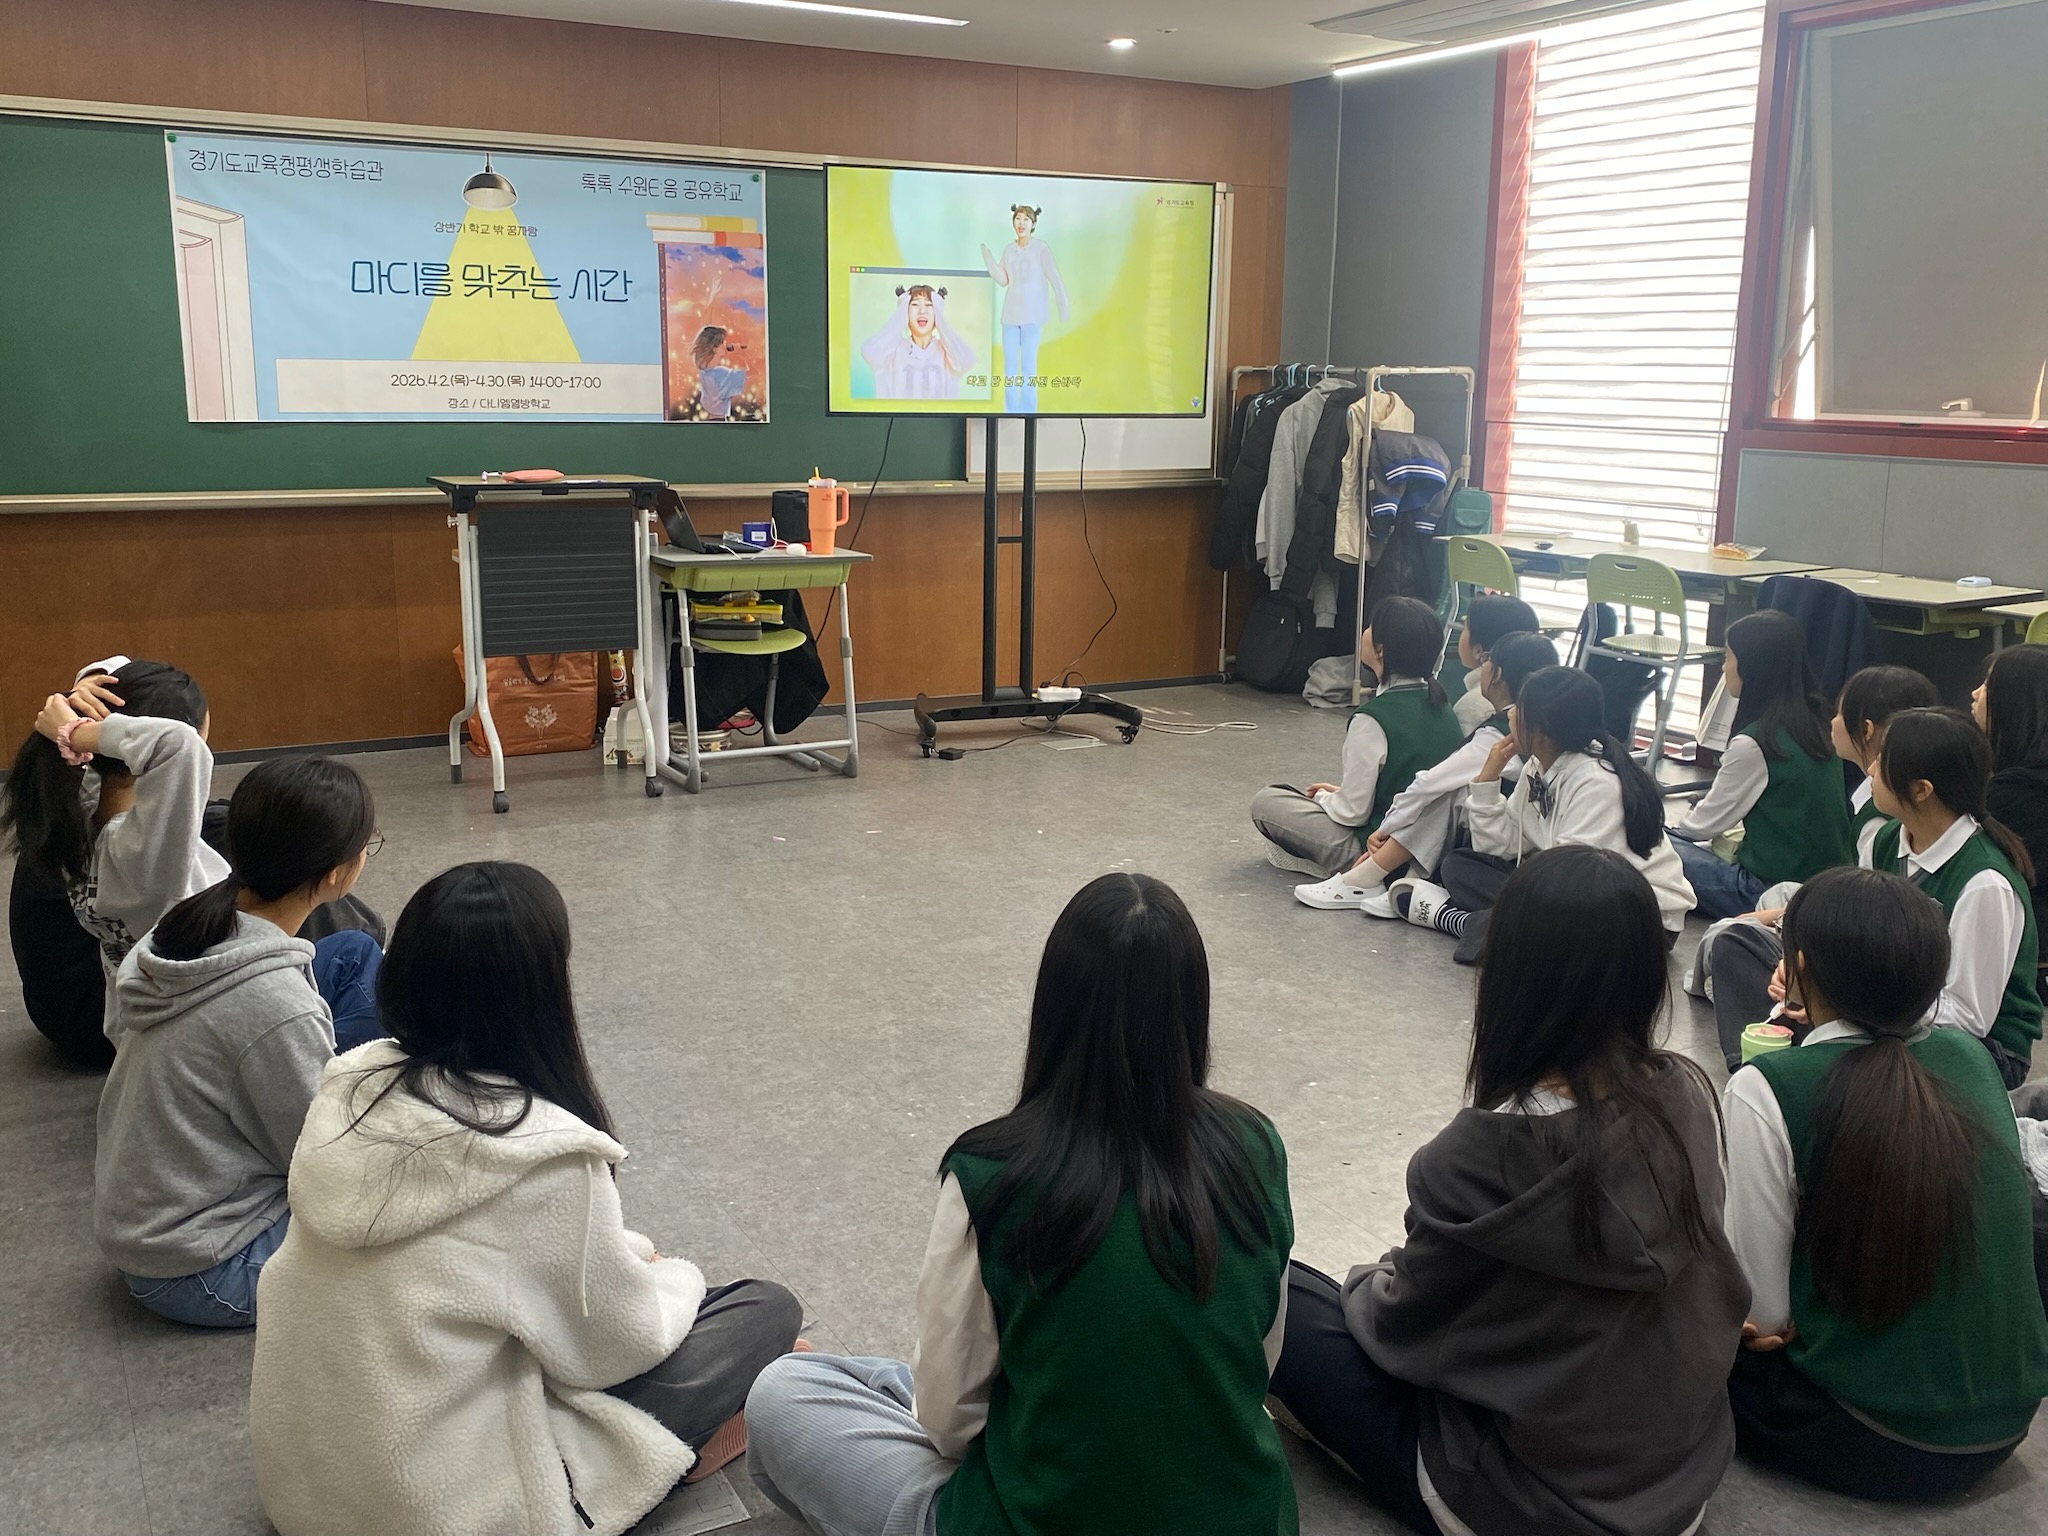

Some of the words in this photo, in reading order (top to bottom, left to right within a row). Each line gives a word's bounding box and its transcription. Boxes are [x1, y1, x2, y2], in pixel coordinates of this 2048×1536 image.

[188, 149, 384, 182] 경기도교육청평생학습관
[581, 173, 613, 195] 톡톡
[683, 180, 744, 202] 공유학교
[434, 222, 466, 233] 상반기
[469, 223, 490, 234] 학교
[493, 224, 504, 235] 밖
[351, 260, 454, 297] 마디를
[462, 264, 561, 300] 맞추는
[568, 268, 633, 302] 시간
[966, 375, 988, 388] 학교
[1050, 376, 1082, 389] 손바닥
[447, 398, 469, 409] 장소
